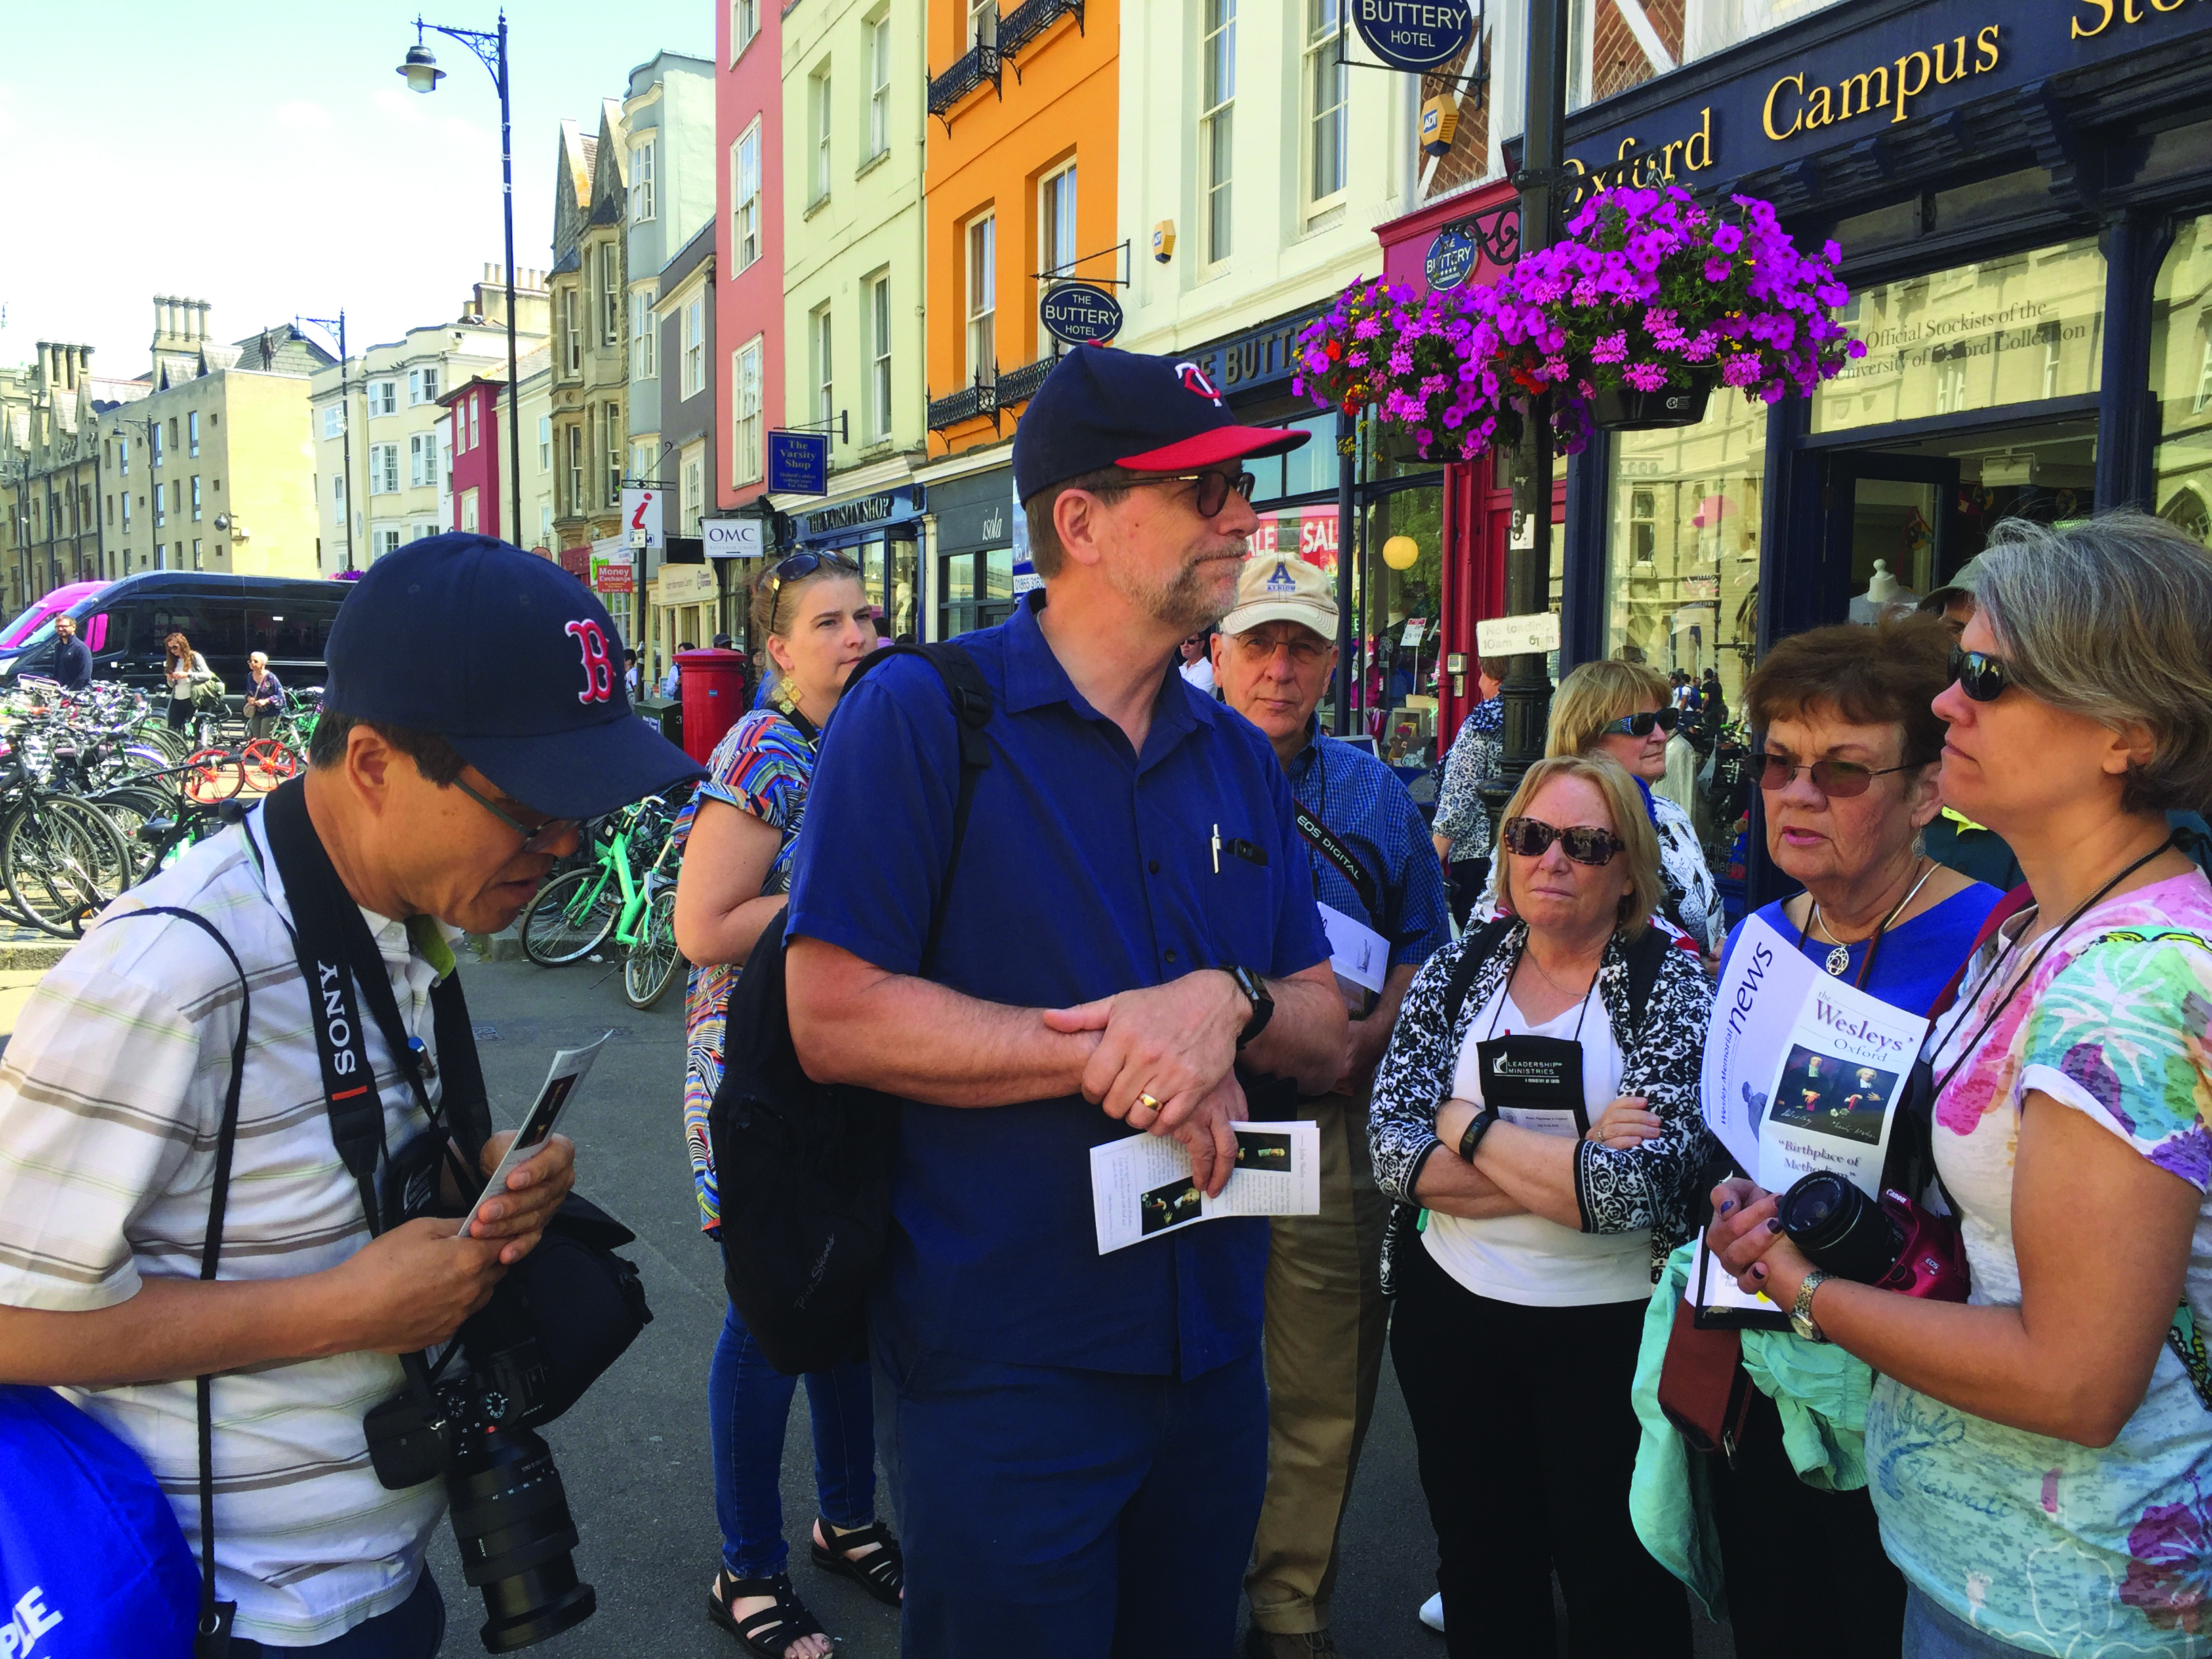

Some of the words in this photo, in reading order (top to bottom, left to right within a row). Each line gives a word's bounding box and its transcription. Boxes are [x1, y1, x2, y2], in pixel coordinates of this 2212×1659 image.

[1362, 0, 1467, 30] BUTTERY
[1391, 30, 1435, 47] HOTEL
[1761, 24, 2000, 140] Campus
[1424, 111, 1438, 130] ADT
[1072, 294, 1092, 305] THE
[1046, 305, 1120, 325] BUTTERY
[1065, 325, 1097, 336] HOTEL
[1865, 322, 1921, 350] Official
[1926, 310, 1994, 337] Stockists
[1999, 302, 2020, 325] of
[2020, 300, 2047, 319] the
[1912, 347, 1931, 367] of
[788, 440, 808, 449] The
[780, 449, 817, 461] Varsity
[785, 459, 811, 470] Shop
[807, 512, 823, 533] THE
[823, 499, 865, 531] VARSITY
[863, 495, 895, 524] SHOP
[982, 508, 1003, 541] isola
[709, 528, 756, 543] OMC
[1246, 526, 1276, 557] ALE
[1302, 519, 1339, 554] SAL
[1014, 544, 1022, 562] To
[598, 567, 630, 577] Money
[1267, 562, 1296, 584] A
[1015, 577, 1029, 591] 01865
[1486, 626, 1502, 636] No
[1483, 638, 1512, 650] 10am
[565, 618, 617, 705] B
[1296, 815, 1322, 839] EOS
[1322, 837, 1359, 880] DIGITAL
[1701, 841, 1713, 855] of
[1715, 842, 1731, 856] the
[1728, 941, 1773, 1036] news
[1818, 991, 1832, 1002] the
[317, 960, 356, 1076] SONY
[1721, 1027, 1734, 1084] Memorial
[1834, 1038, 1888, 1062] Oxford
[1720, 1085, 1728, 1125] Wesley
[1847, 1156, 1862, 1168] of
[1885, 1188, 1907, 1204] Canon
[1925, 1258, 1940, 1269] EOS
[478, 1538, 487, 1557] SONY
